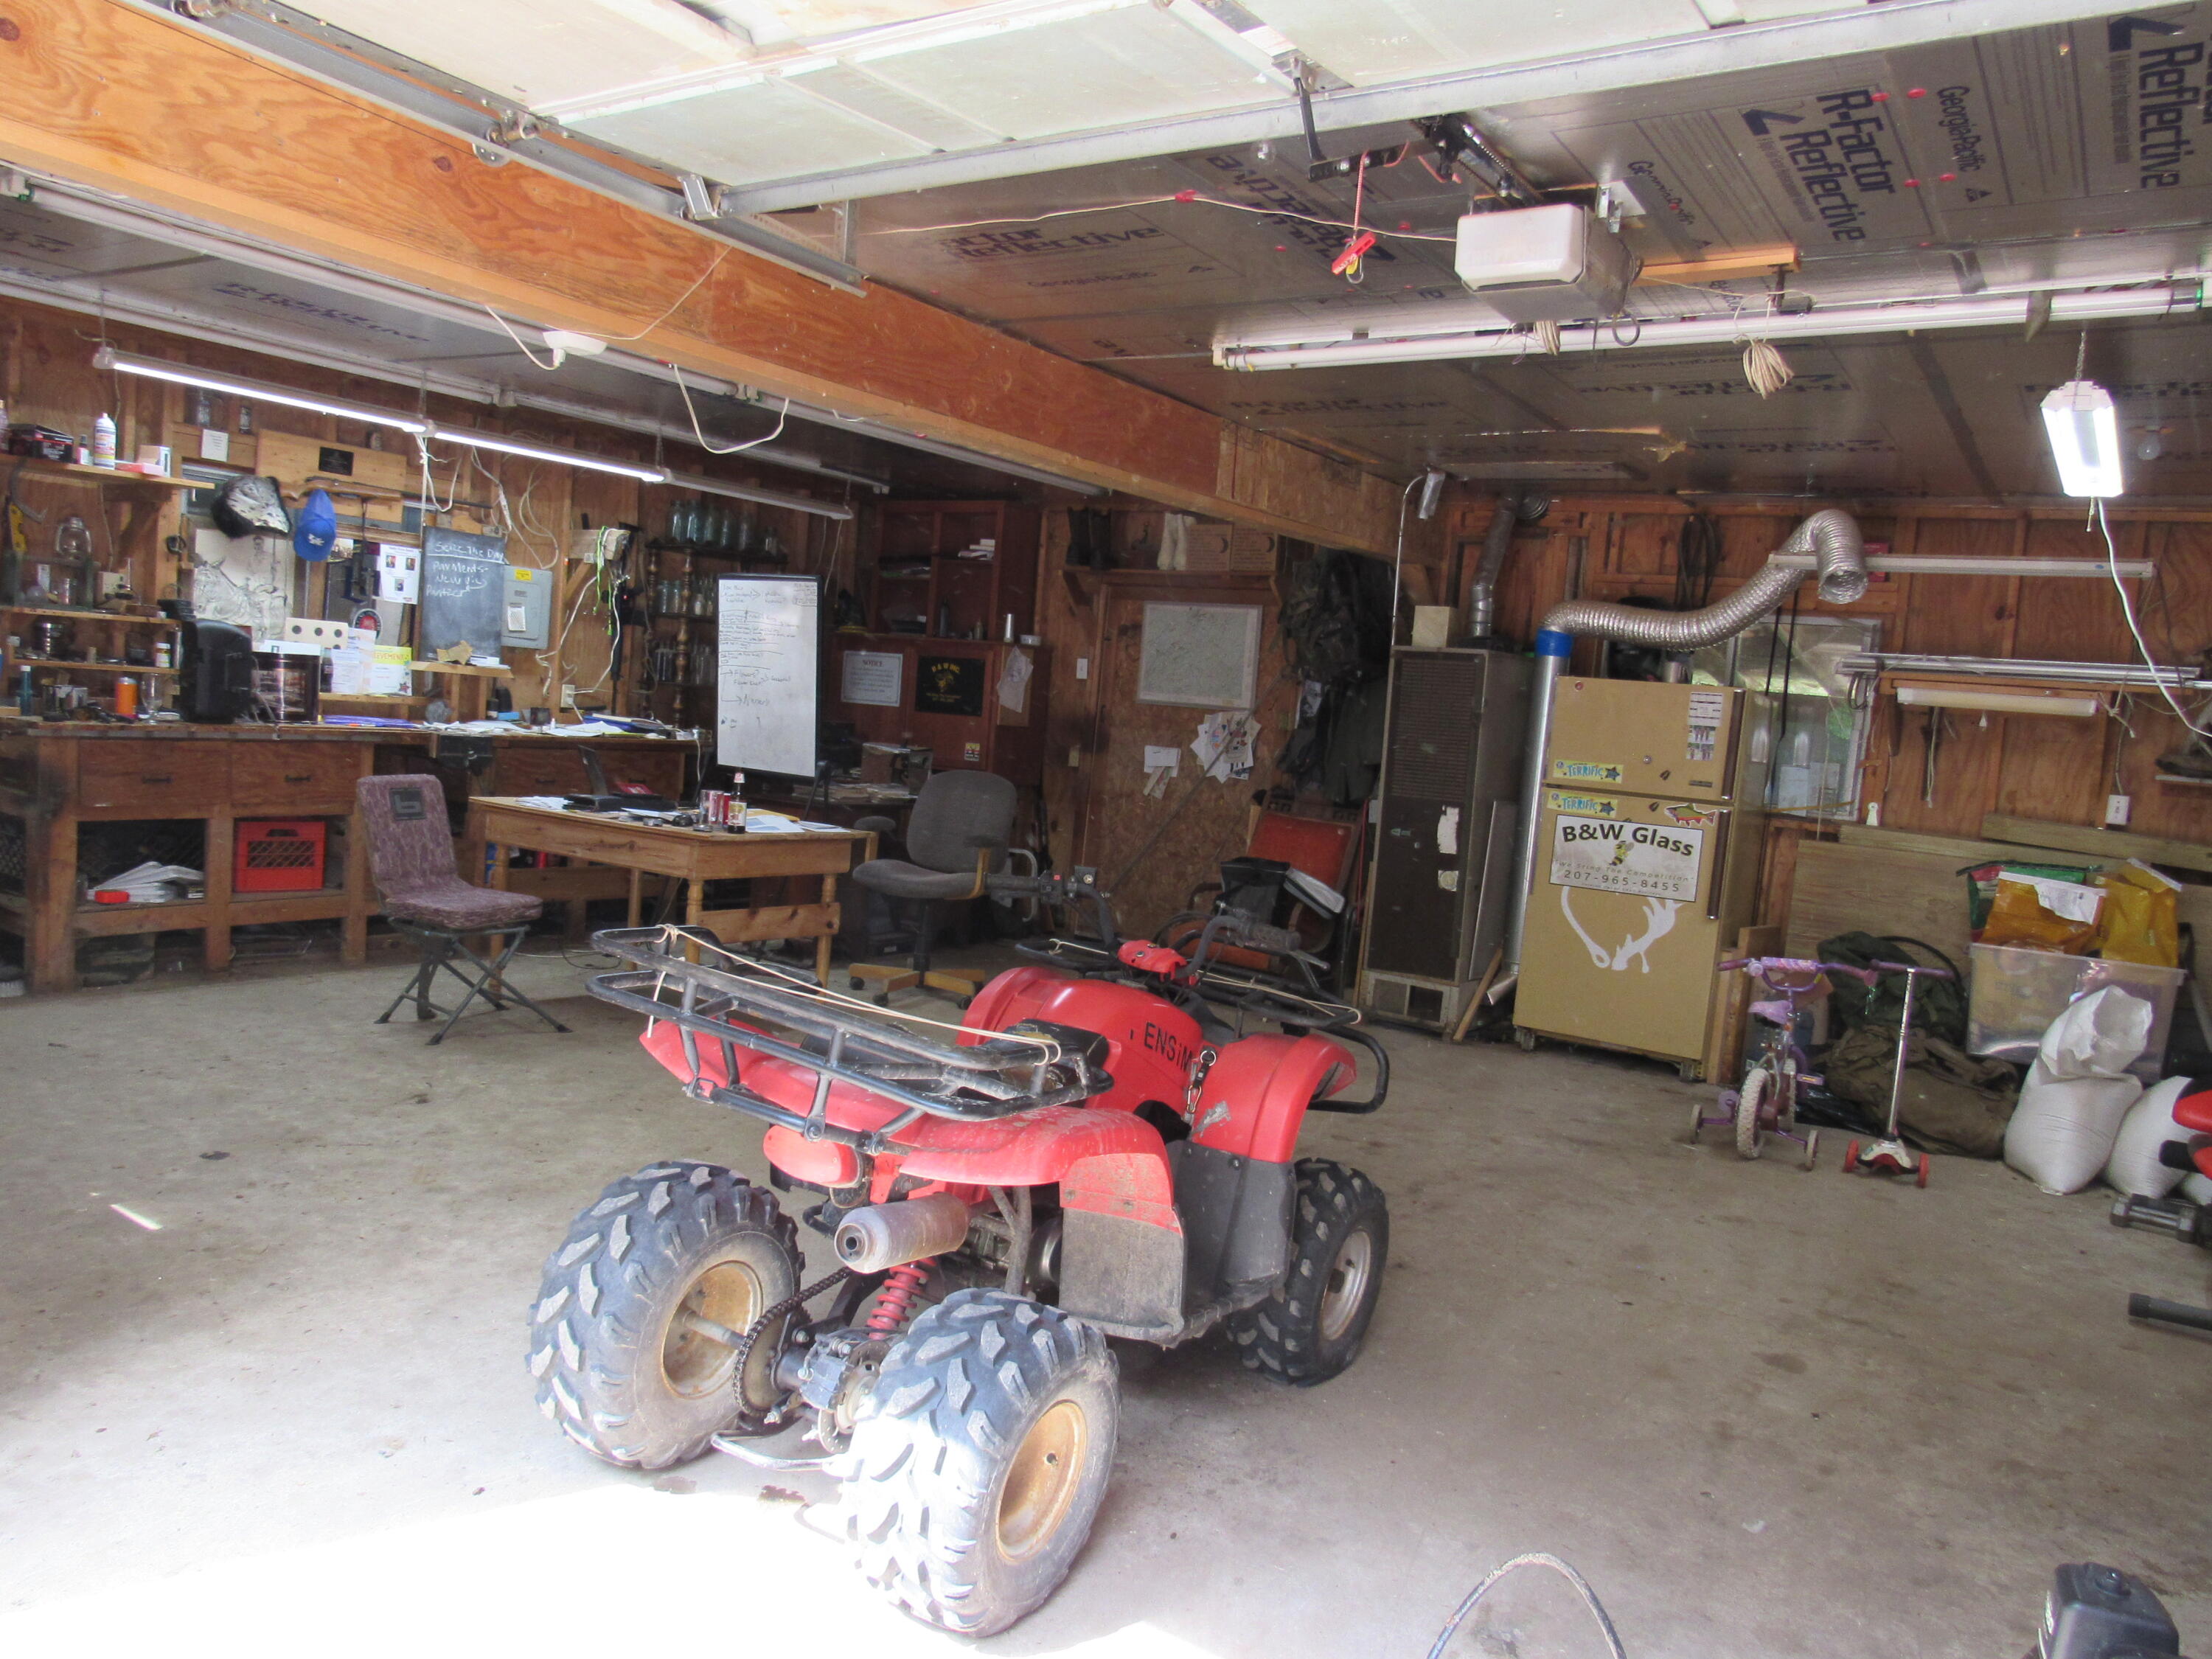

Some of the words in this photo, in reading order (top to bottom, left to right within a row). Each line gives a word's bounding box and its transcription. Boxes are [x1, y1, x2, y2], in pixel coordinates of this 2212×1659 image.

[1816, 89, 1896, 194] R-Factor
[2139, 42, 2205, 189] Reflective
[1779, 129, 1866, 242] Reflective
[1562, 824, 1624, 842] B&W
[1632, 827, 1694, 856] Glass
[1564, 870, 1680, 892] 207-965-8455
